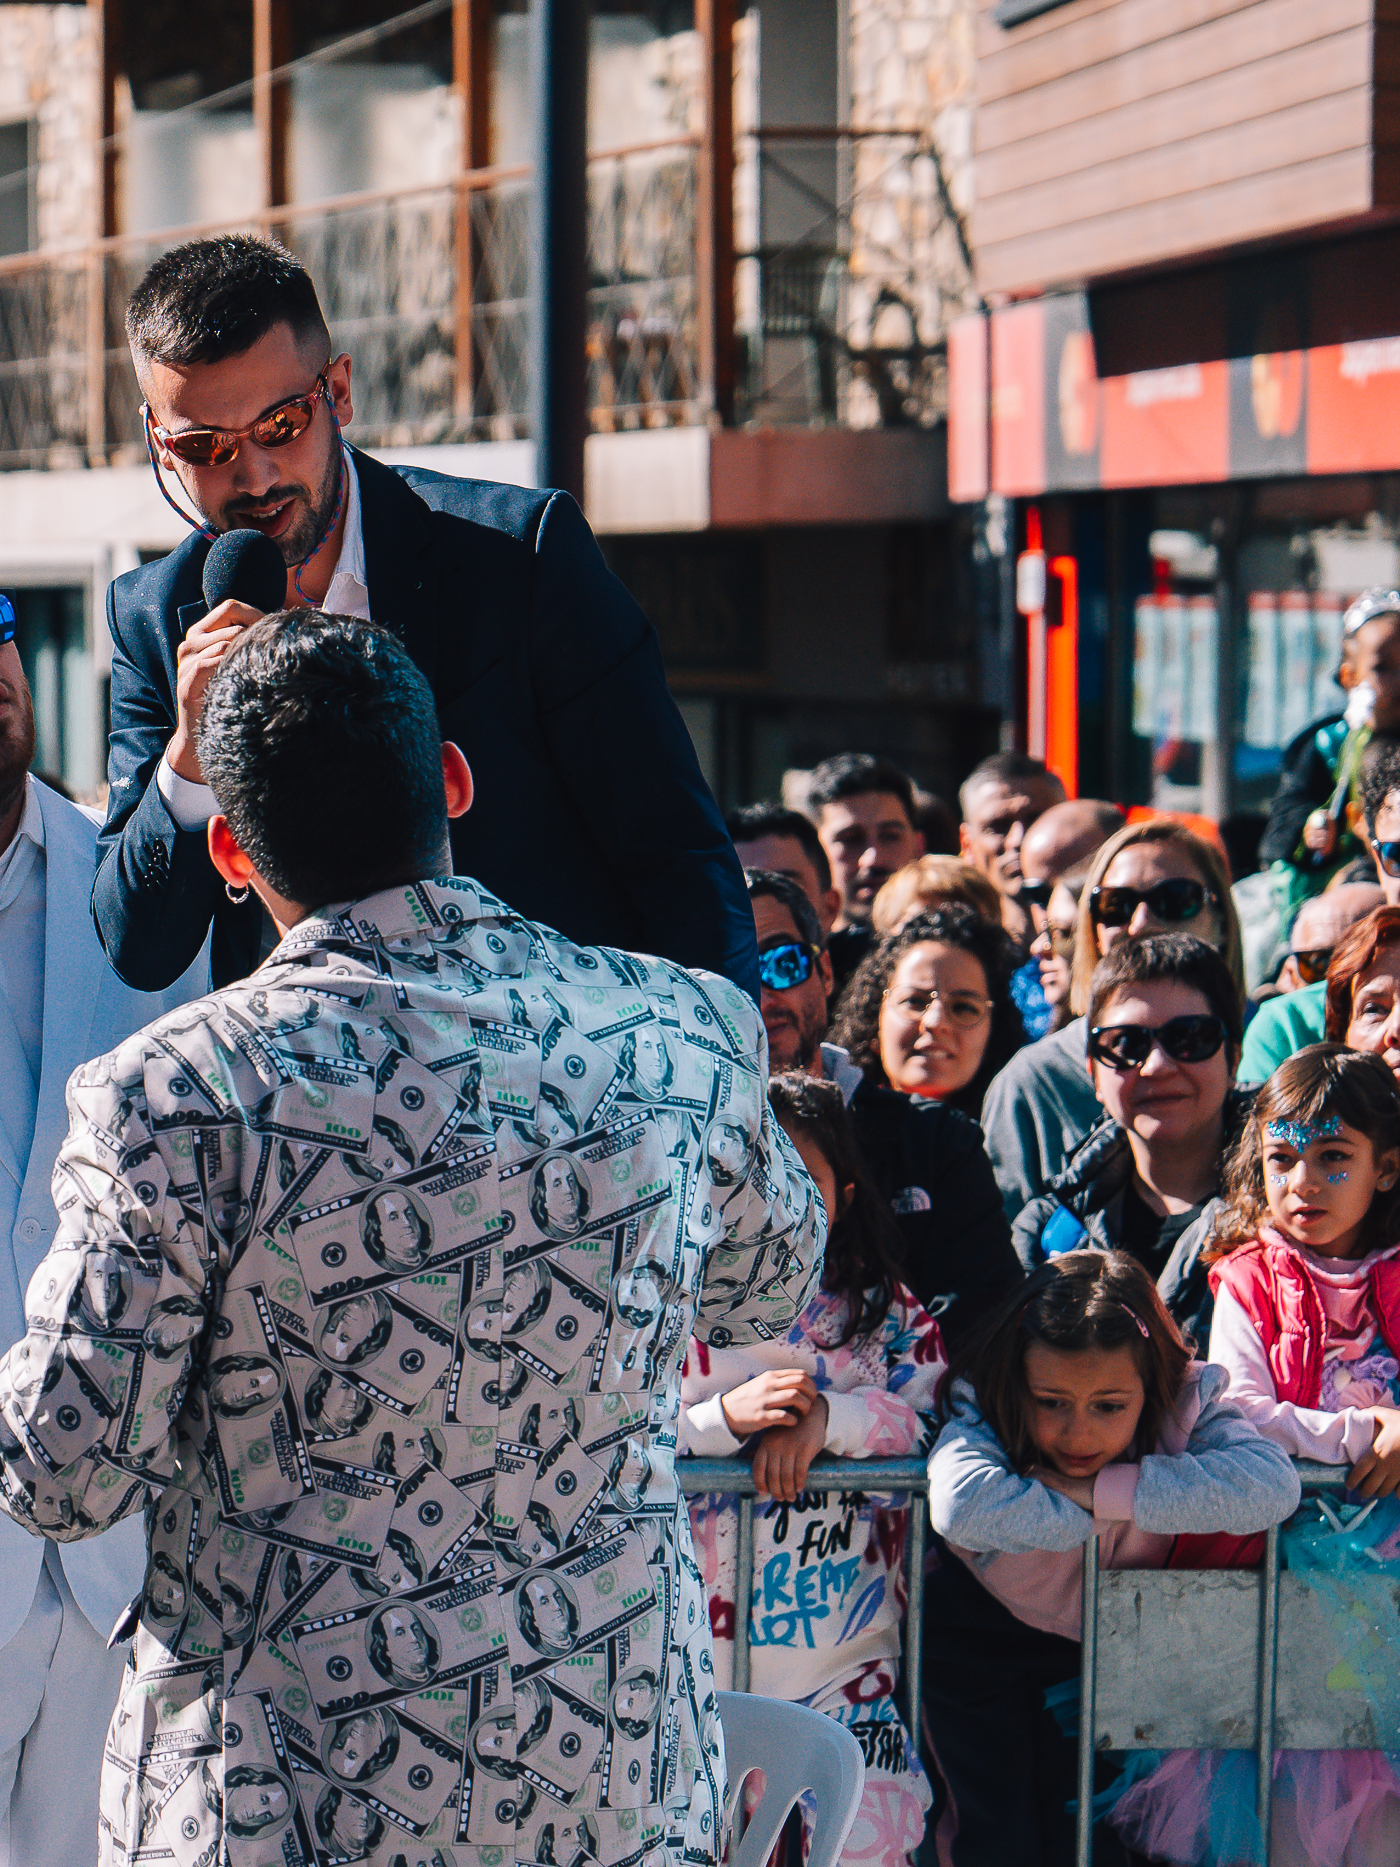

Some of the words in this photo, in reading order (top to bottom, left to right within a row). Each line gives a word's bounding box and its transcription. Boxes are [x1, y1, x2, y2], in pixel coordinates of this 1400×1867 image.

[616, 1003, 643, 1018] 100
[486, 1022, 535, 1040] 100
[497, 1091, 529, 1105] 100
[325, 1122, 361, 1138] 100
[604, 1111, 649, 1136] 100
[446, 1144, 496, 1167] 100
[636, 1180, 664, 1198] 100
[299, 1198, 351, 1221] 100
[321, 1276, 365, 1295] 100
[256, 1296, 275, 1344] 100
[344, 1466, 396, 1486] 100
[336, 1536, 373, 1553] 100
[587, 1521, 628, 1549] 100
[796, 1509, 854, 1567] FUN
[621, 1587, 648, 1609] 100
[303, 1612, 356, 1633] 100
[328, 1691, 371, 1711] 100
[264, 1701, 284, 1758] 100
